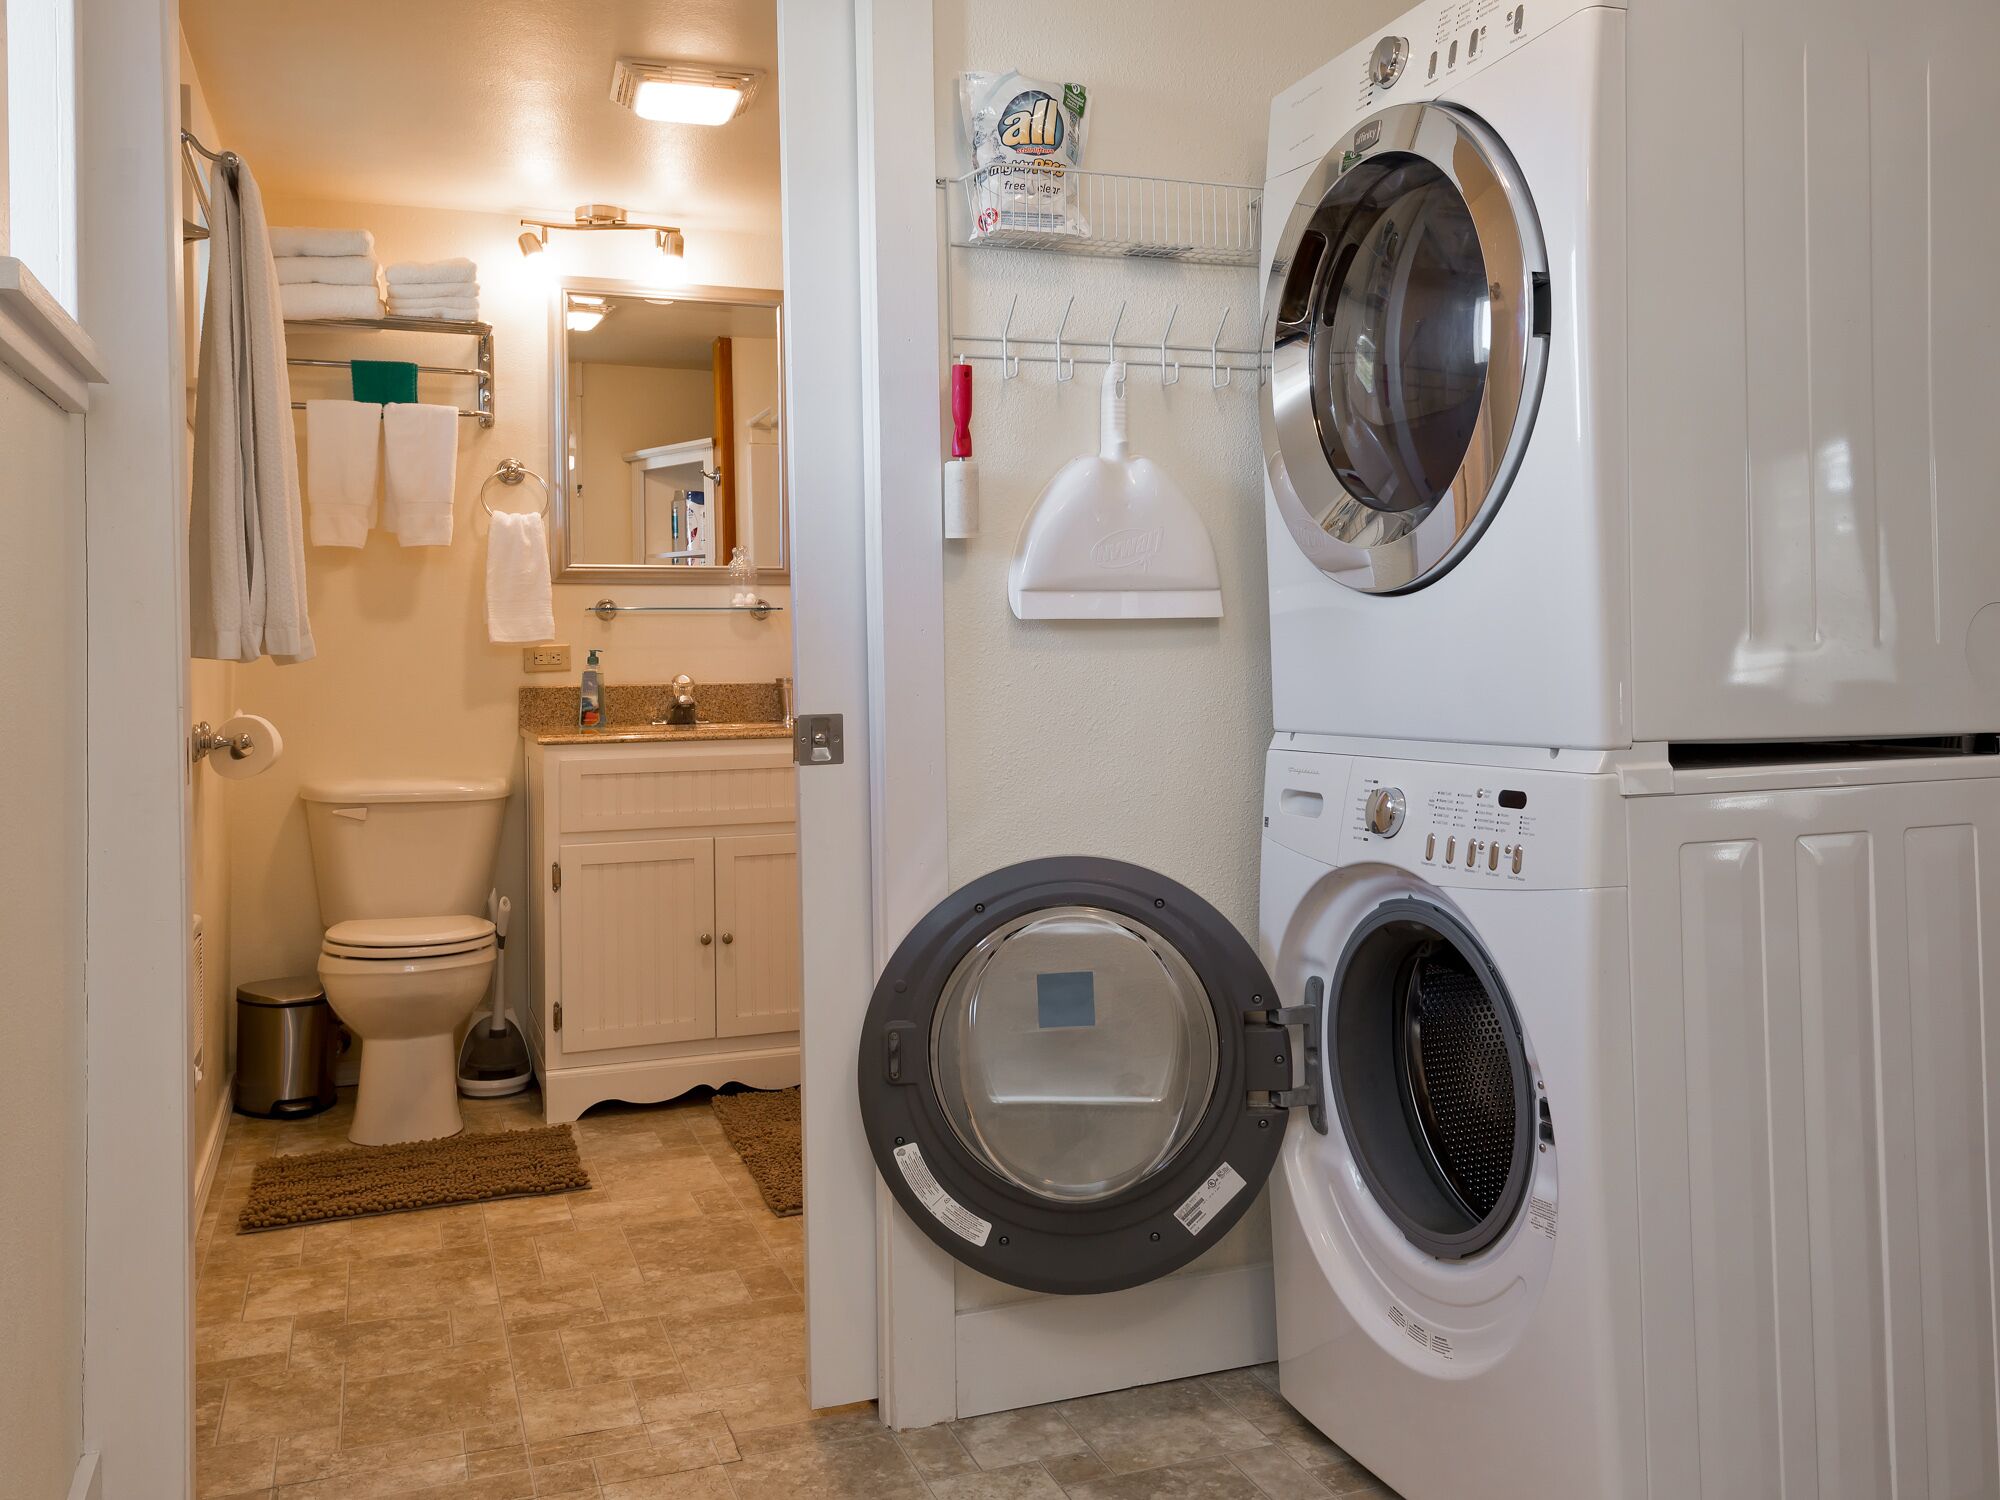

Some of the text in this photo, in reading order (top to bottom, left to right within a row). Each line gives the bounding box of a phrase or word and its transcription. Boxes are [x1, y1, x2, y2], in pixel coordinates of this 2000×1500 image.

[1002, 99, 1058, 146] all
[1356, 129, 1377, 145] affinity
[1004, 180, 1026, 190] free
